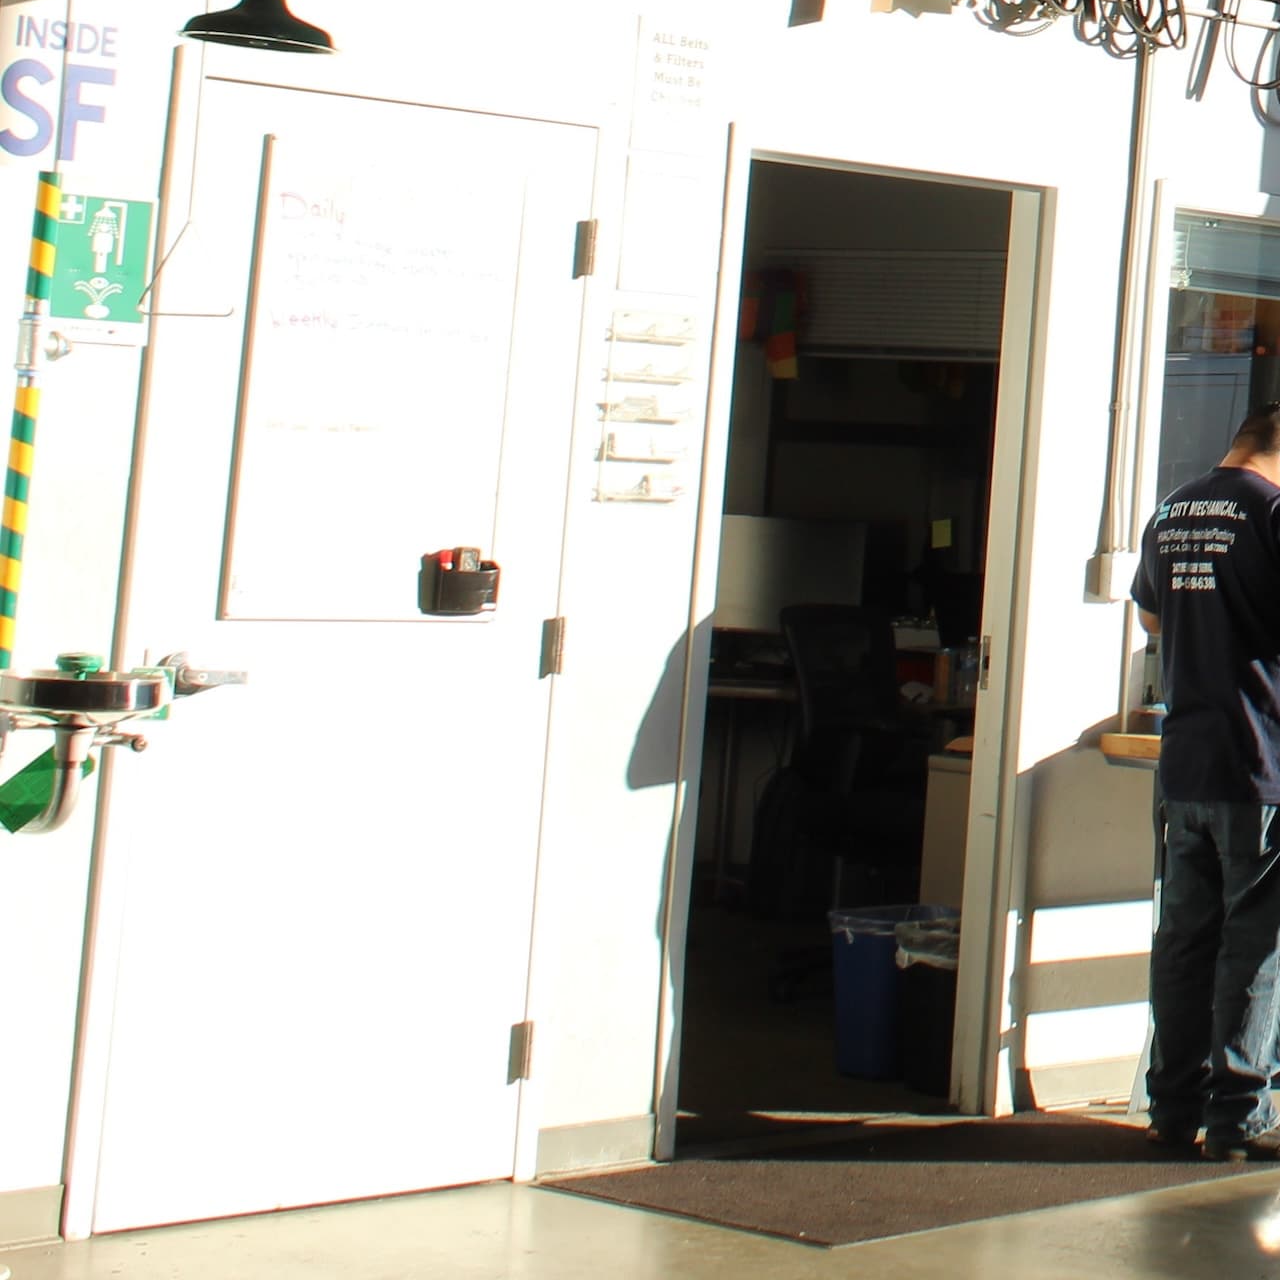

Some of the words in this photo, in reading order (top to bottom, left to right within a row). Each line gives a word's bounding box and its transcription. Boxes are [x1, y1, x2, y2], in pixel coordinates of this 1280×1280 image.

[15, 14, 119, 58] INSIDE
[0, 57, 118, 162] SF
[279, 191, 346, 229] Daily
[1169, 501, 1191, 519] CITY
